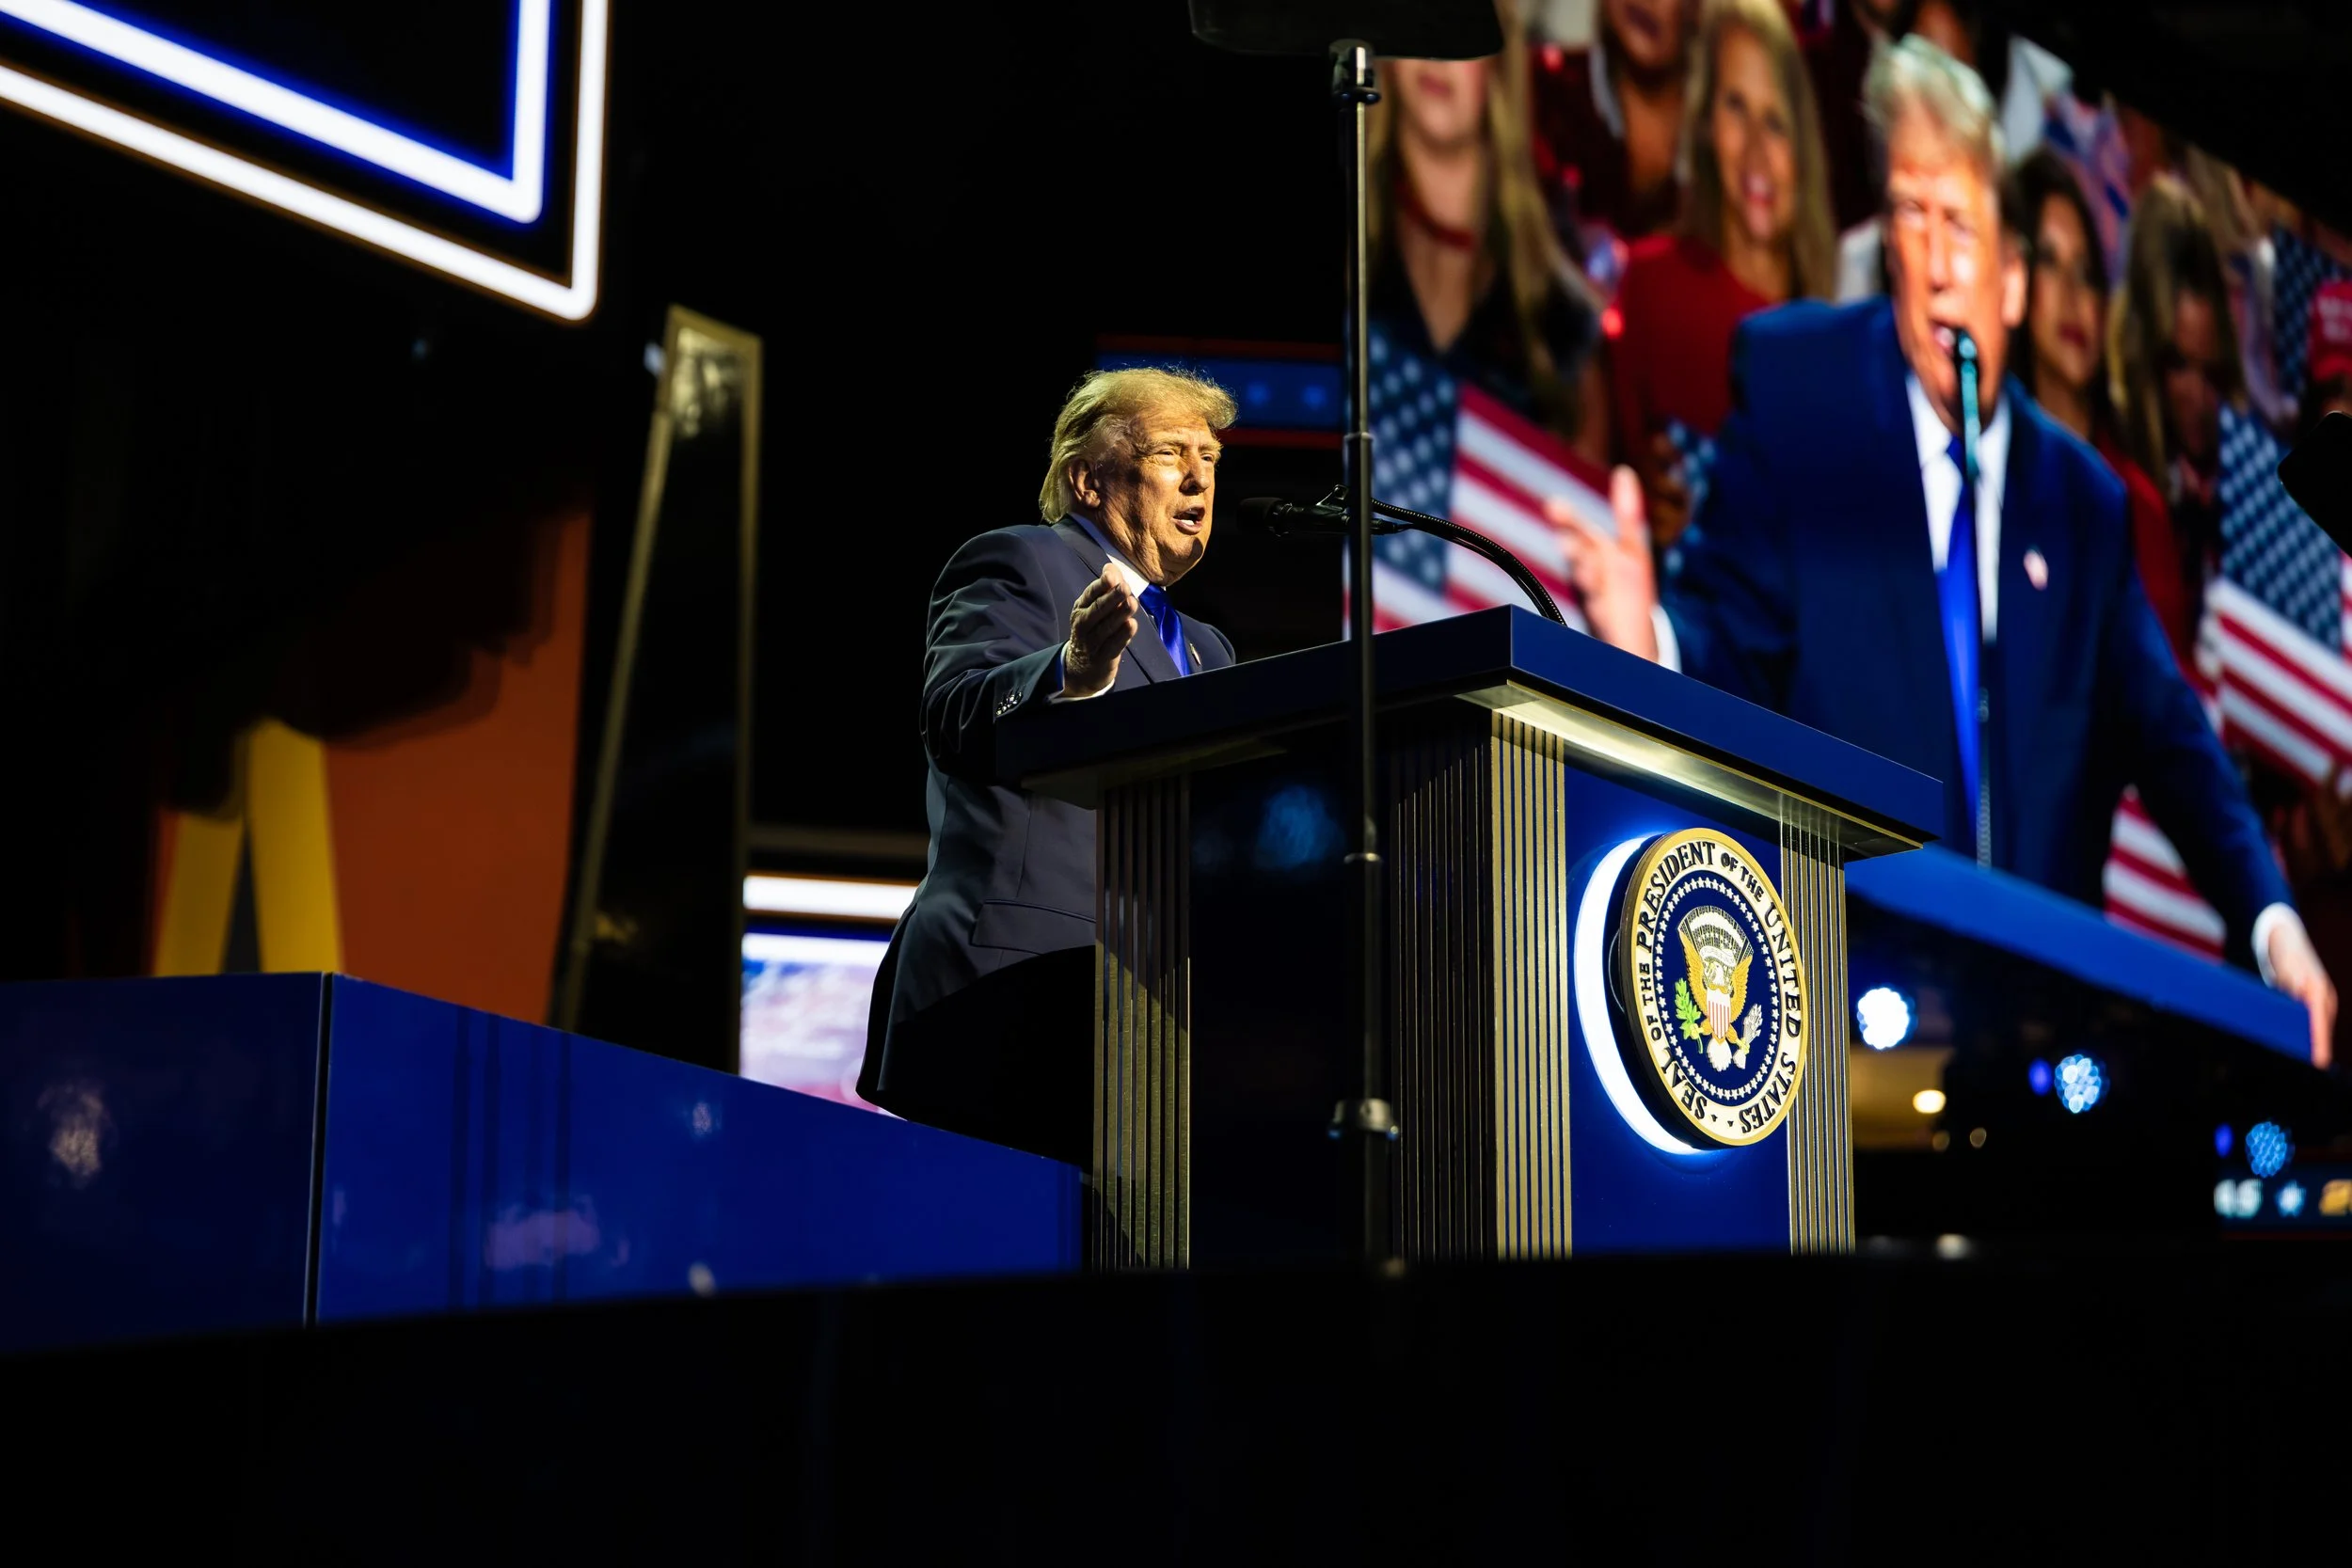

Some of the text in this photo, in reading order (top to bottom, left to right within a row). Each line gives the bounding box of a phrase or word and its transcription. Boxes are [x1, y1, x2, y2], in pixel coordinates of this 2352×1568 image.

[1636, 841, 1802, 1134] SEAL OF THE PRESIDENT OF THE UNITED STATES
